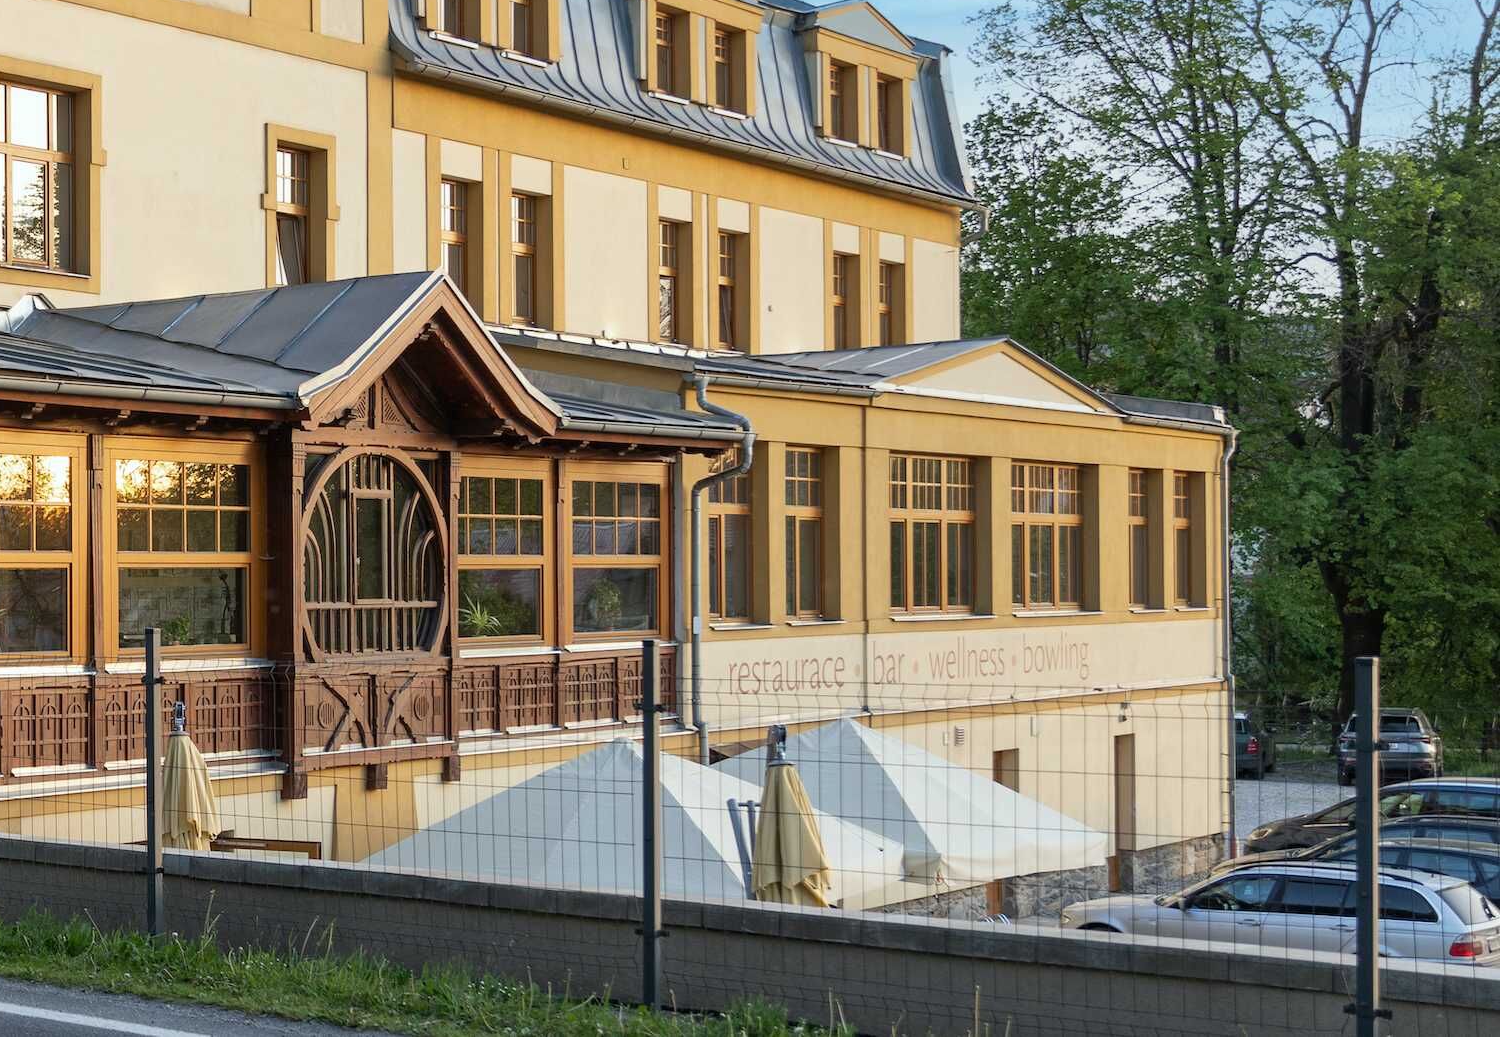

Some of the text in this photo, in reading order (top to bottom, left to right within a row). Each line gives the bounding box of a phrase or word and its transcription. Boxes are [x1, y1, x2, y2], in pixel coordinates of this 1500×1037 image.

[728, 632, 1090, 696] restaurace bar wellness bowling
